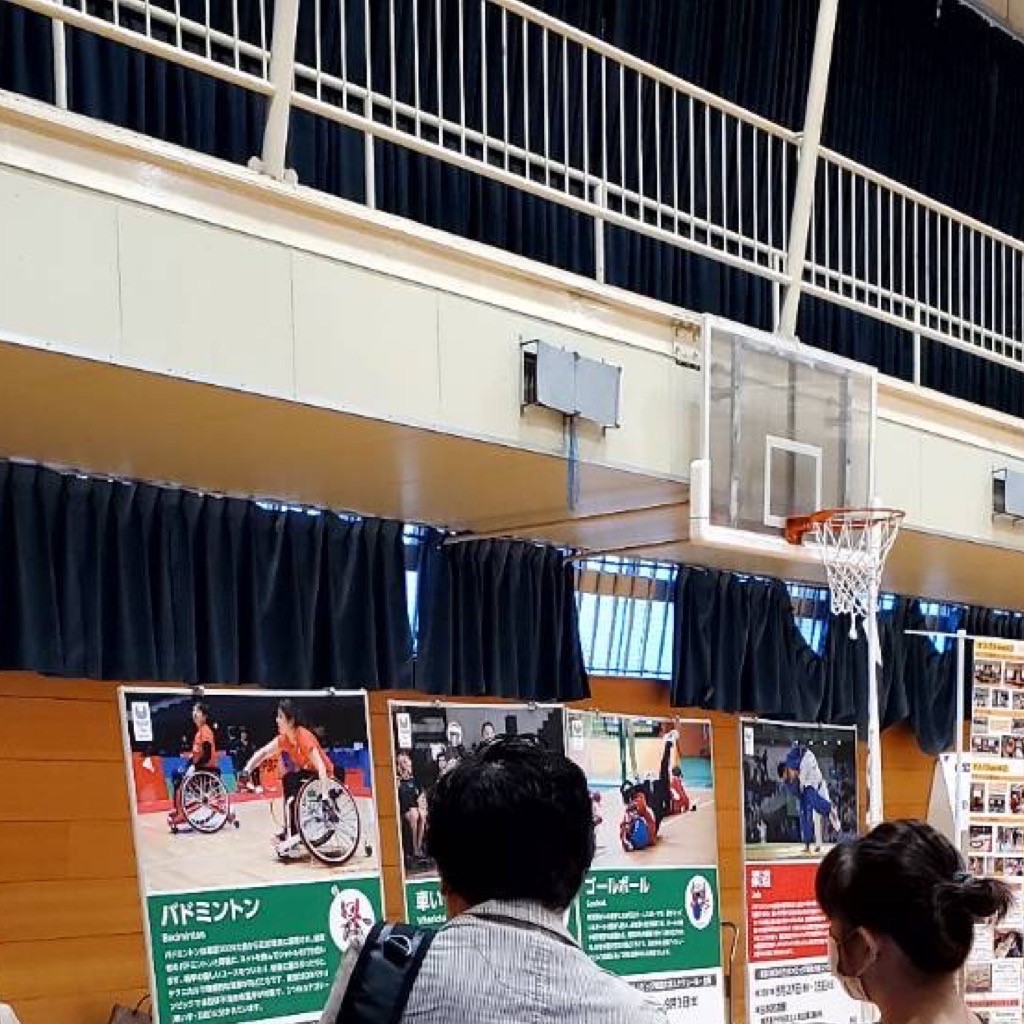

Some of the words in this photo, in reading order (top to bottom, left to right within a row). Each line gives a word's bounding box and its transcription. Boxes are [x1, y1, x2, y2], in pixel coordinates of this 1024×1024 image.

[585, 875, 651, 895] ゴールボール
[161, 897, 261, 927] バドミントン
